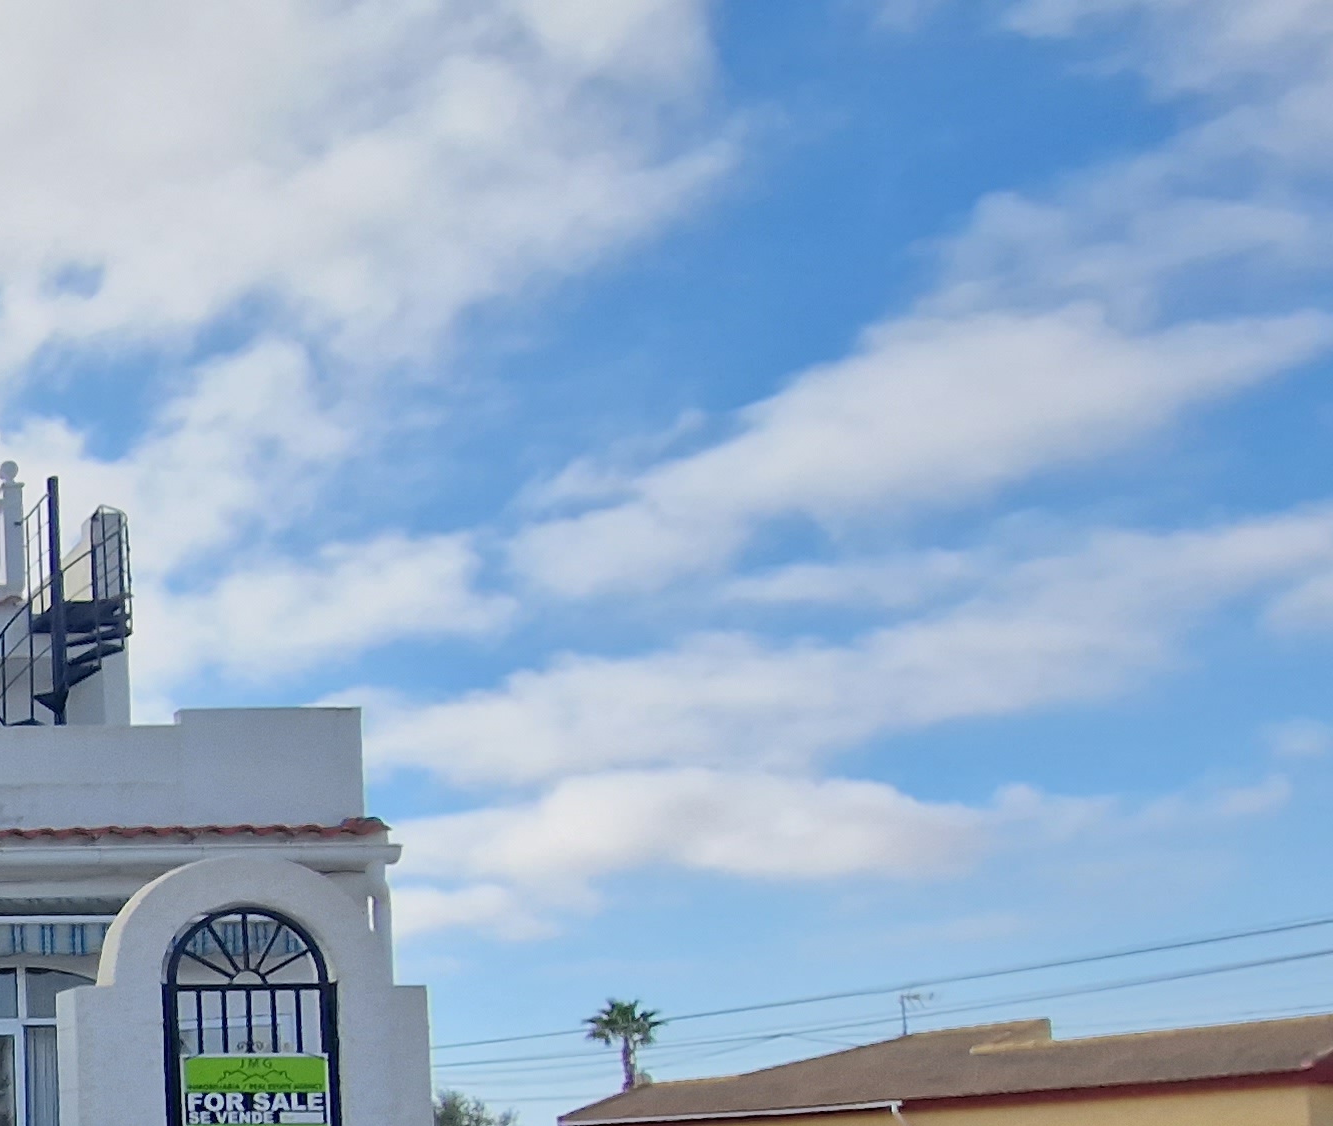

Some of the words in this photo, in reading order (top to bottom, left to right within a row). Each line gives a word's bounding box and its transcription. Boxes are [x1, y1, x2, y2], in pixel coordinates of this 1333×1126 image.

[187, 1092, 245, 1112] FOR
[252, 1092, 324, 1112] SALE
[188, 1111, 211, 1124] SE
[216, 1111, 275, 1124] VENDE
